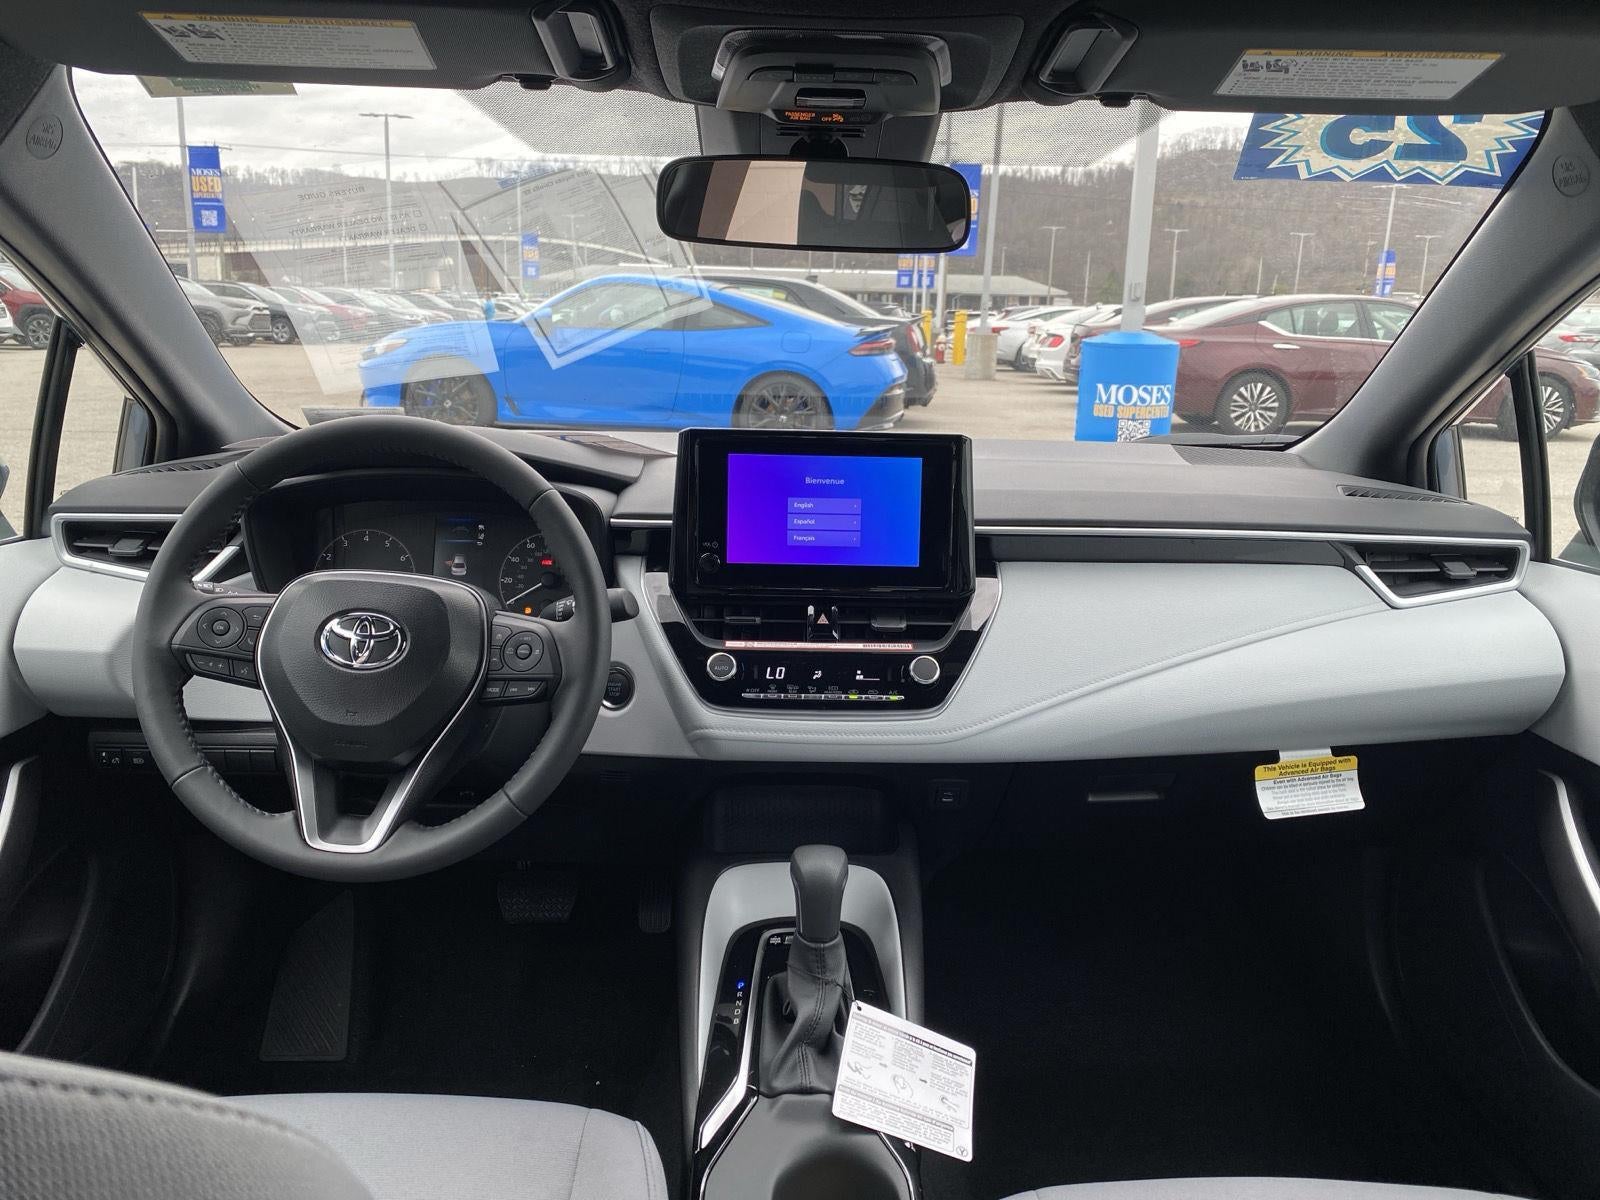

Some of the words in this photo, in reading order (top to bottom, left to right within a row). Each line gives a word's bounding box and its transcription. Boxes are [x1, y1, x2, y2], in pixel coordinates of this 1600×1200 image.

[191, 168, 221, 176] MOSES
[192, 176, 222, 192] USED
[1096, 383, 1172, 406] MOSES
[805, 477, 844, 485] Bienvenue
[766, 667, 785, 679] LO
[1309, 760, 1337, 769] Equipped
